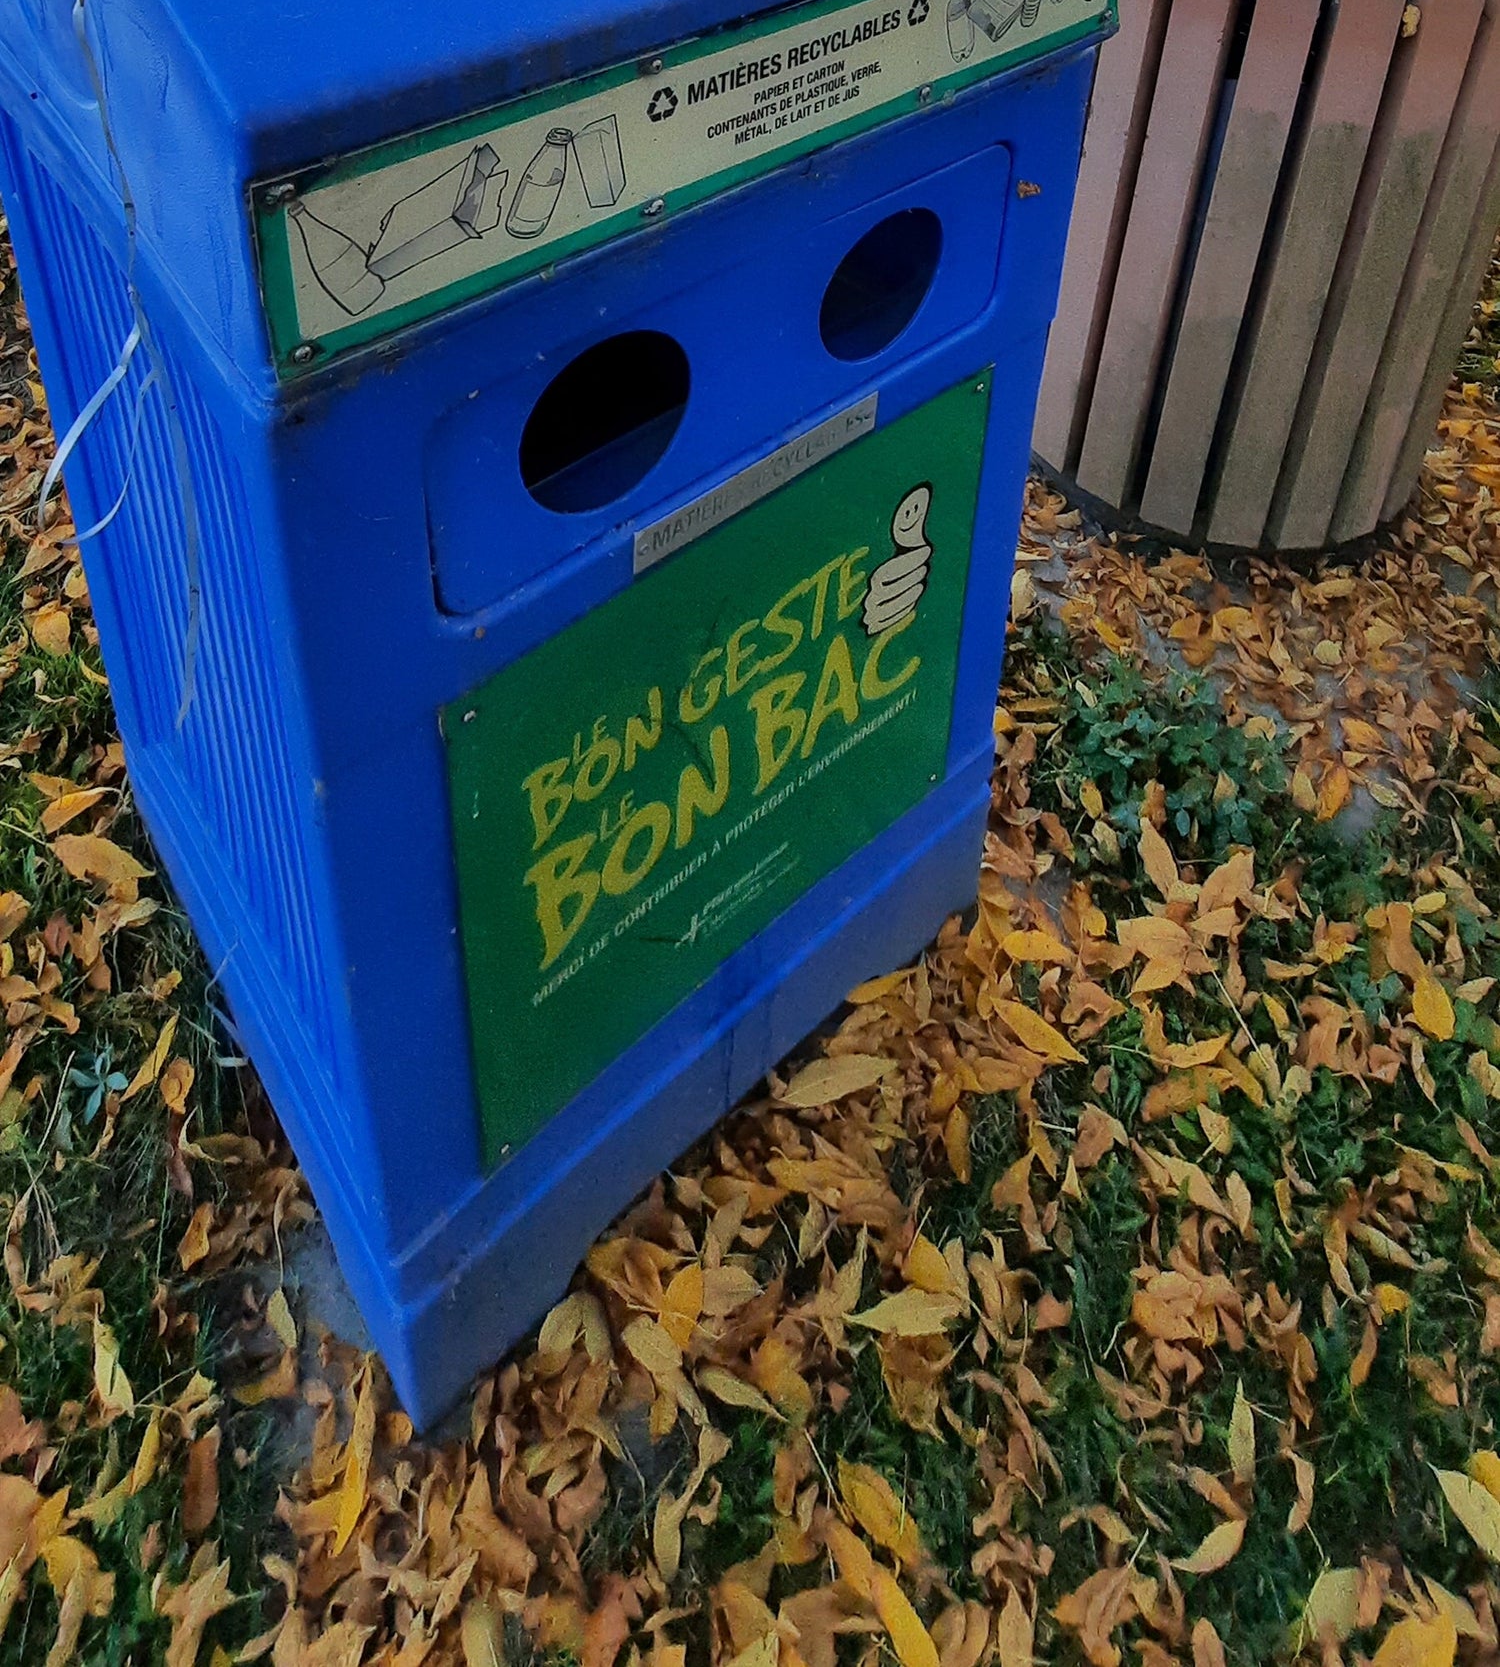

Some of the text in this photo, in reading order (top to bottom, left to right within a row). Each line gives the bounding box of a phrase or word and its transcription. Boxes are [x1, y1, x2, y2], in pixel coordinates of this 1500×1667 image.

[687, 9, 901, 105] MATIÈRES RECYCLABLES
[753, 60, 845, 105] PAPIER ET CARTON
[707, 61, 882, 139] CONTENANTS DE PLASTIQUE, VERRE,
[734, 85, 860, 145] MÉTAL, DE LAIT ET DE JUS
[652, 485, 742, 550] MATIER
[522, 547, 869, 850] BON GESTE
[573, 715, 607, 766] LE
[524, 612, 921, 971] BON BAC
[600, 790, 636, 842] LE
[531, 955, 584, 1006] MERCI
[590, 932, 610, 958] DE
[615, 852, 707, 936] CONTRIBUER
